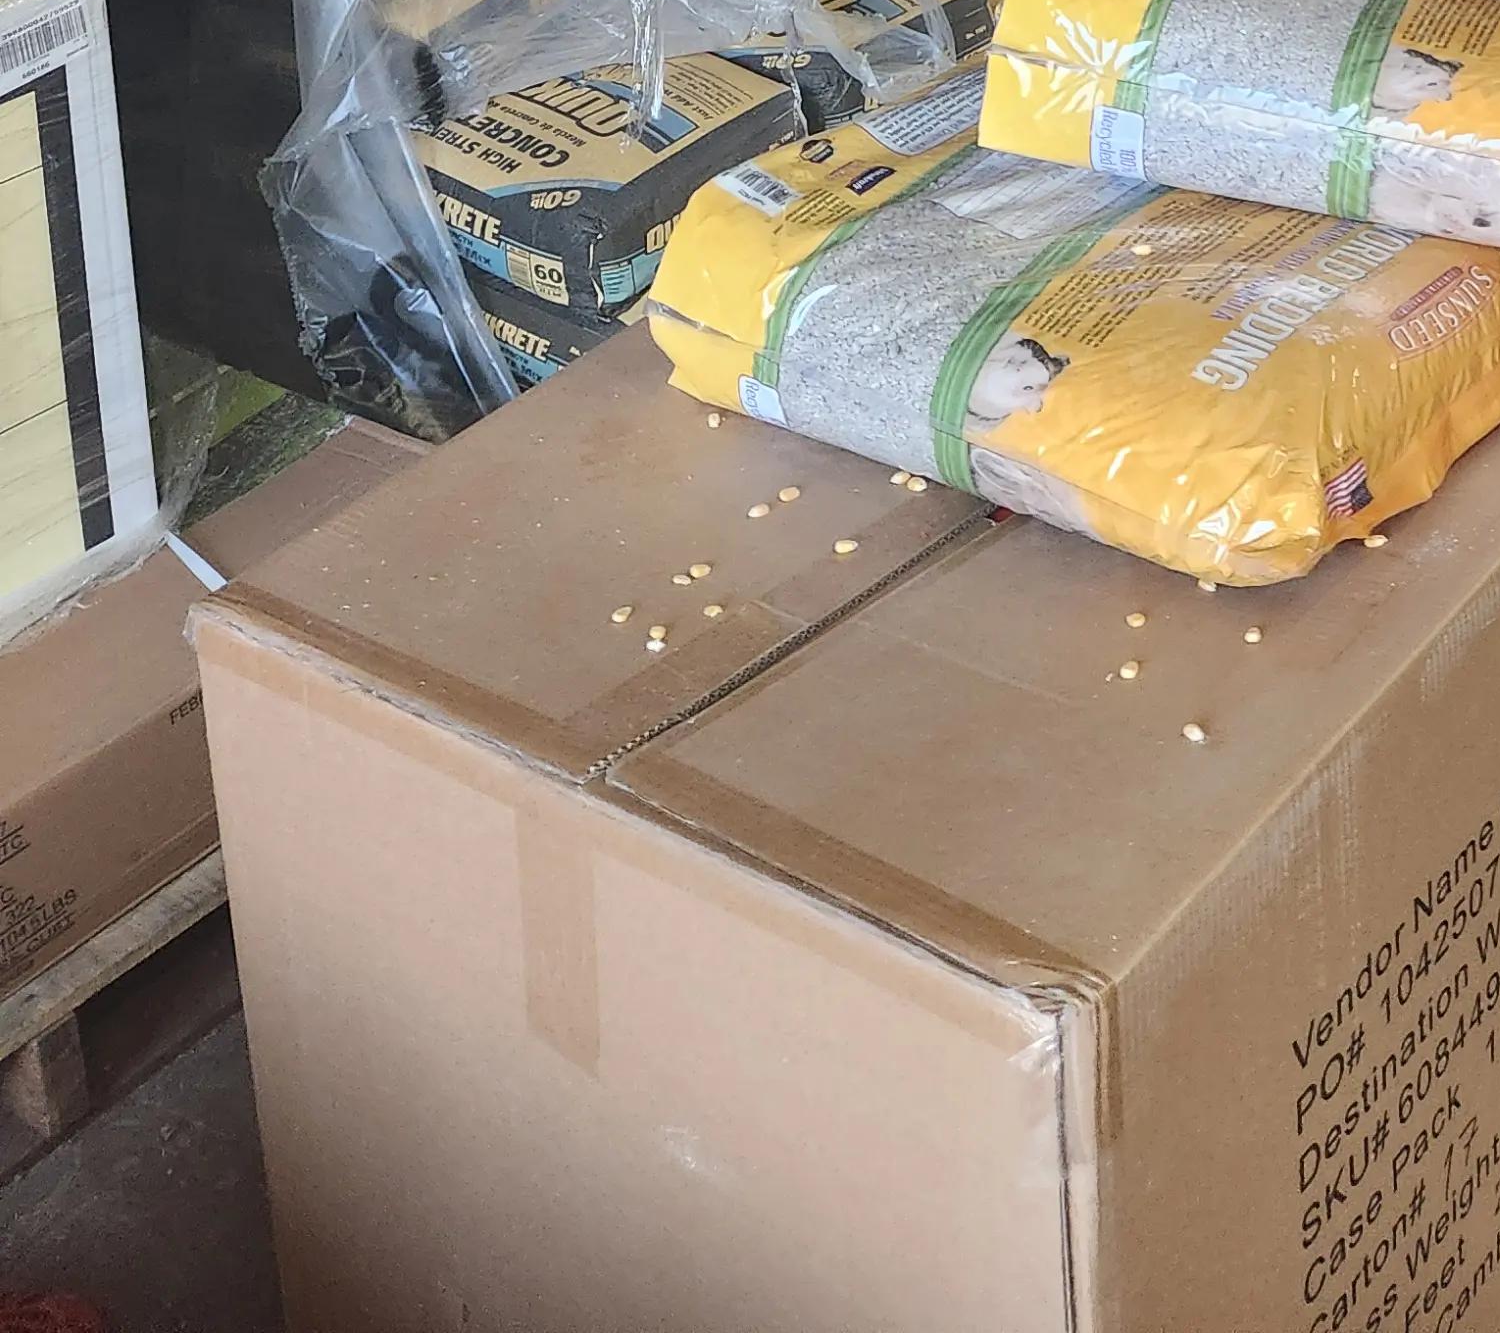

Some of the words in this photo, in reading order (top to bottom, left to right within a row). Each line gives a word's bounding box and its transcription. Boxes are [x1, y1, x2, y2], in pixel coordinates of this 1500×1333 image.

[455, 114, 571, 168] CONCRET
[480, 144, 522, 174] HIGH
[1100, 109, 1121, 171] Recycled
[534, 263, 564, 285] 60
[1387, 263, 1495, 354] SUNSEED
[1189, 273, 1342, 392] BEDDING
[1292, 923, 1405, 1070] Vendor
[1412, 820, 1494, 933] Name
[1296, 1025, 1365, 1135] PO#
[1299, 964, 1469, 1193] Destination
[1301, 1110, 1390, 1250] SKU#
[1304, 1189, 1383, 1305] Case
[1391, 1084, 1462, 1193] Pack
[1484, 1029, 1497, 1063] 1
[1309, 1179, 1426, 1333] Carton#
[1443, 1115, 1479, 1201] 17
[1405, 1133, 1500, 1282] Weight
[1404, 1235, 1465, 1333] Feet
